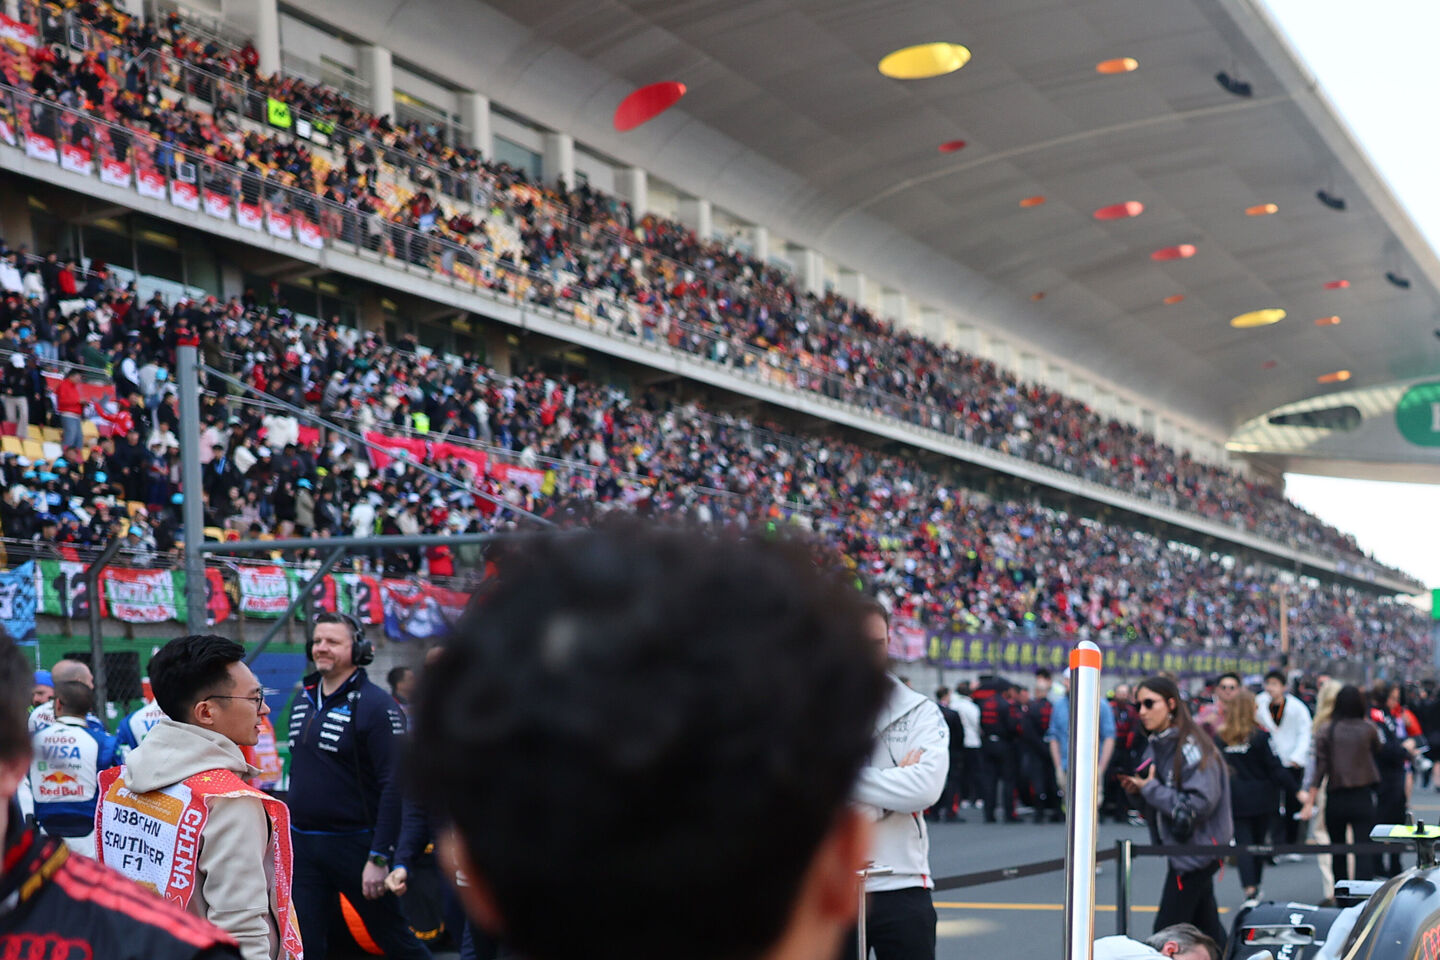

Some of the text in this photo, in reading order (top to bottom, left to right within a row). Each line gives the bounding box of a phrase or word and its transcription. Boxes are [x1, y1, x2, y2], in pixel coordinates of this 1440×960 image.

[44, 736, 76, 744] HUGO
[42, 746, 81, 760] VISA
[39, 785, 84, 797] Red Bull
[171, 808, 203, 890] CHINA
[122, 854, 143, 871] F1
